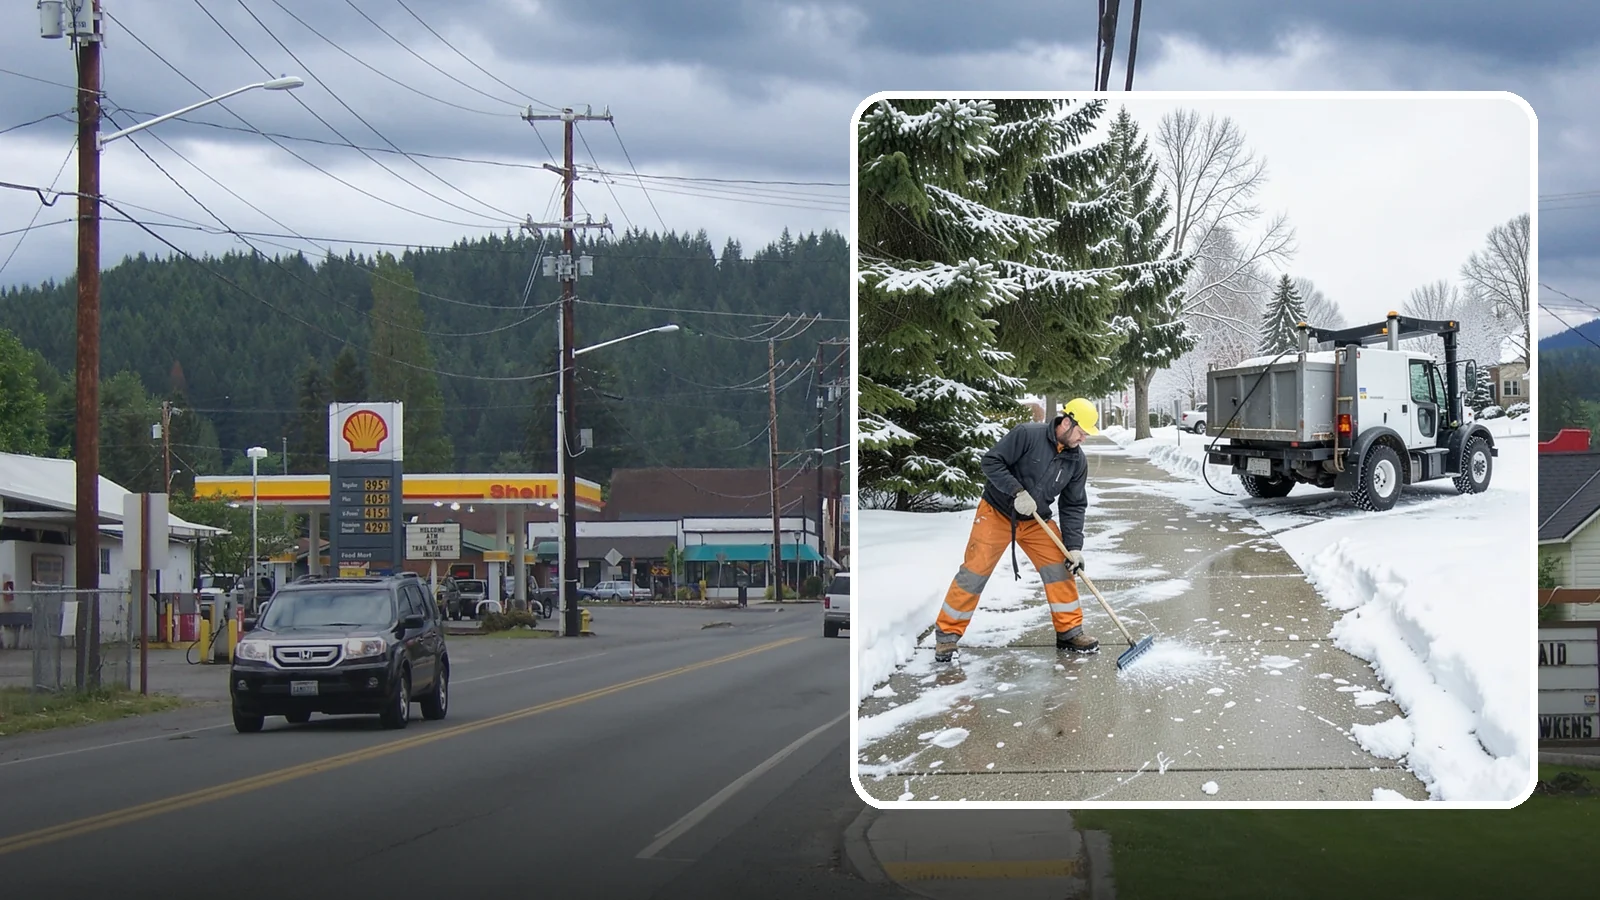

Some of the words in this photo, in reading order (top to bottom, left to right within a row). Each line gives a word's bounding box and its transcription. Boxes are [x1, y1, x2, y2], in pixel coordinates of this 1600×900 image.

[366, 480, 383, 490] 395
[490, 484, 547, 499] Shell
[366, 494, 383, 504] 405
[366, 508, 383, 518] 415
[366, 522, 384, 533] 429
